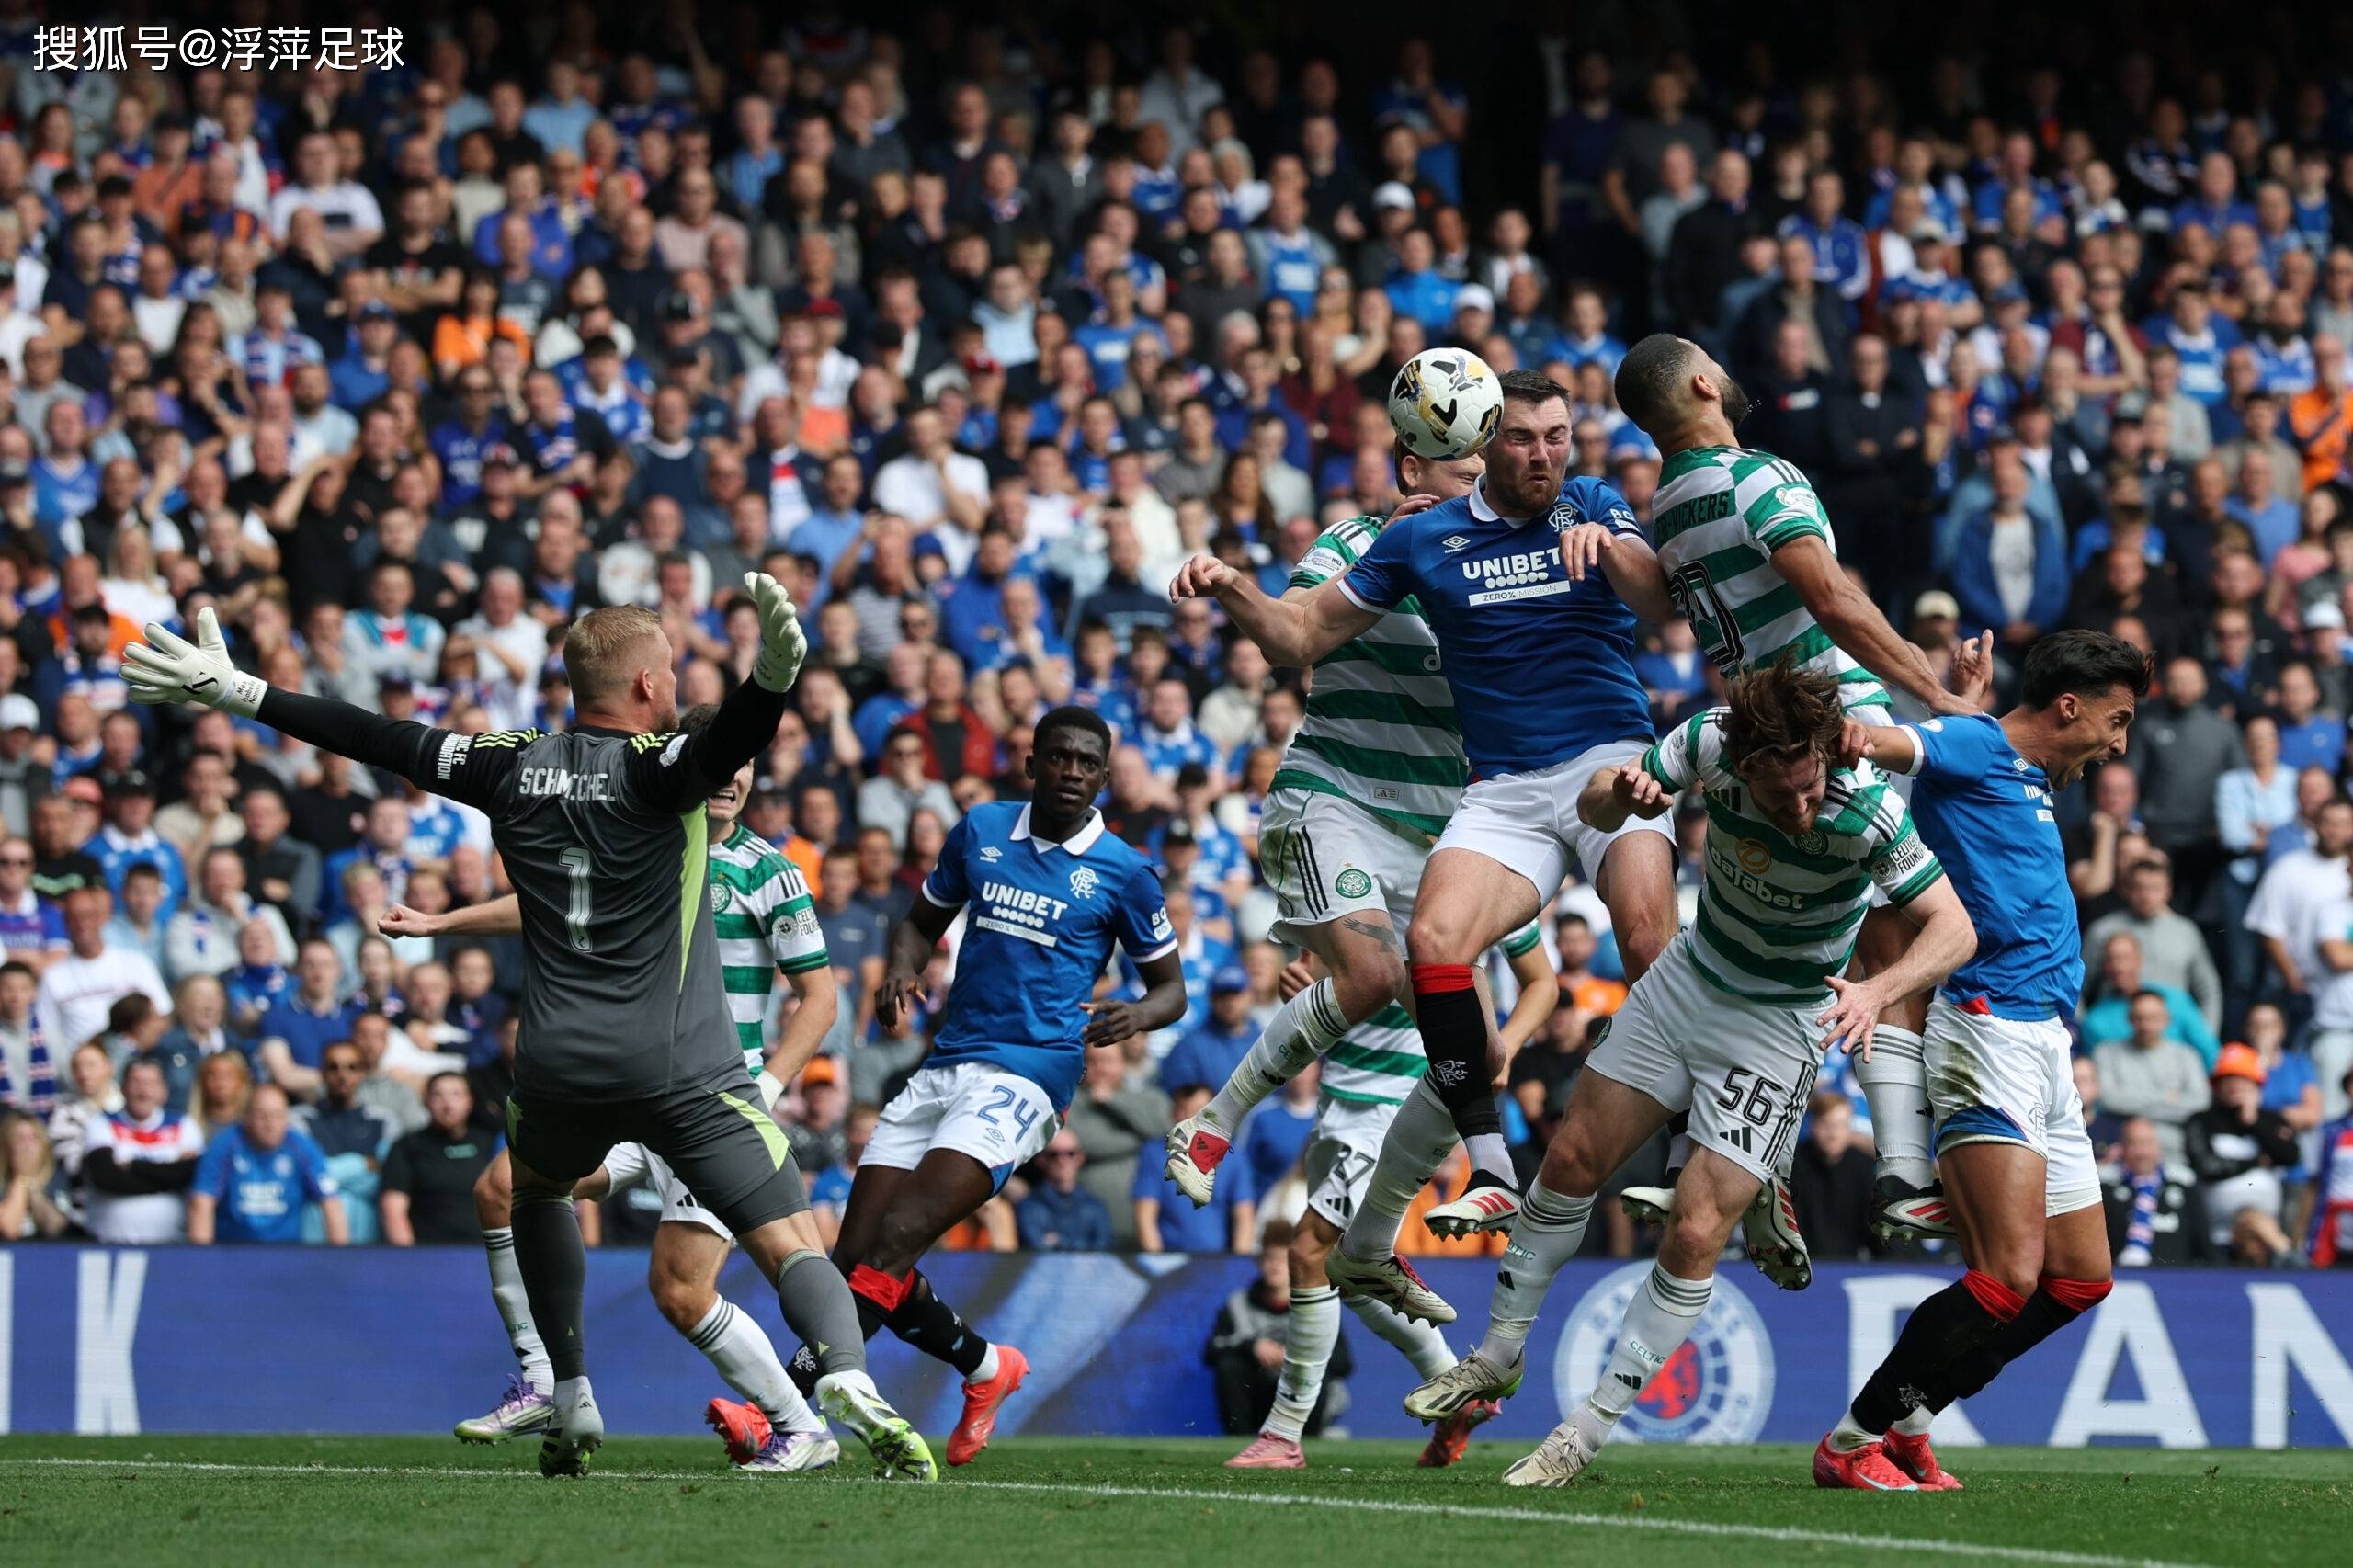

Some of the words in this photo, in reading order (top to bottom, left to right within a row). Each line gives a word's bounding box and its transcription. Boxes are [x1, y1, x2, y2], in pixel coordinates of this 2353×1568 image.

[1462, 546, 1561, 580] UNIBET
[1483, 591, 1516, 602] ZERO%
[1518, 584, 1557, 598] MISSION
[559, 846, 593, 953] 1
[982, 881, 1068, 921] UNIBET
[977, 1085, 1040, 1144] 24
[1717, 1068, 1783, 1126] 56
[1630, 1340, 1665, 1364] CELTIC
